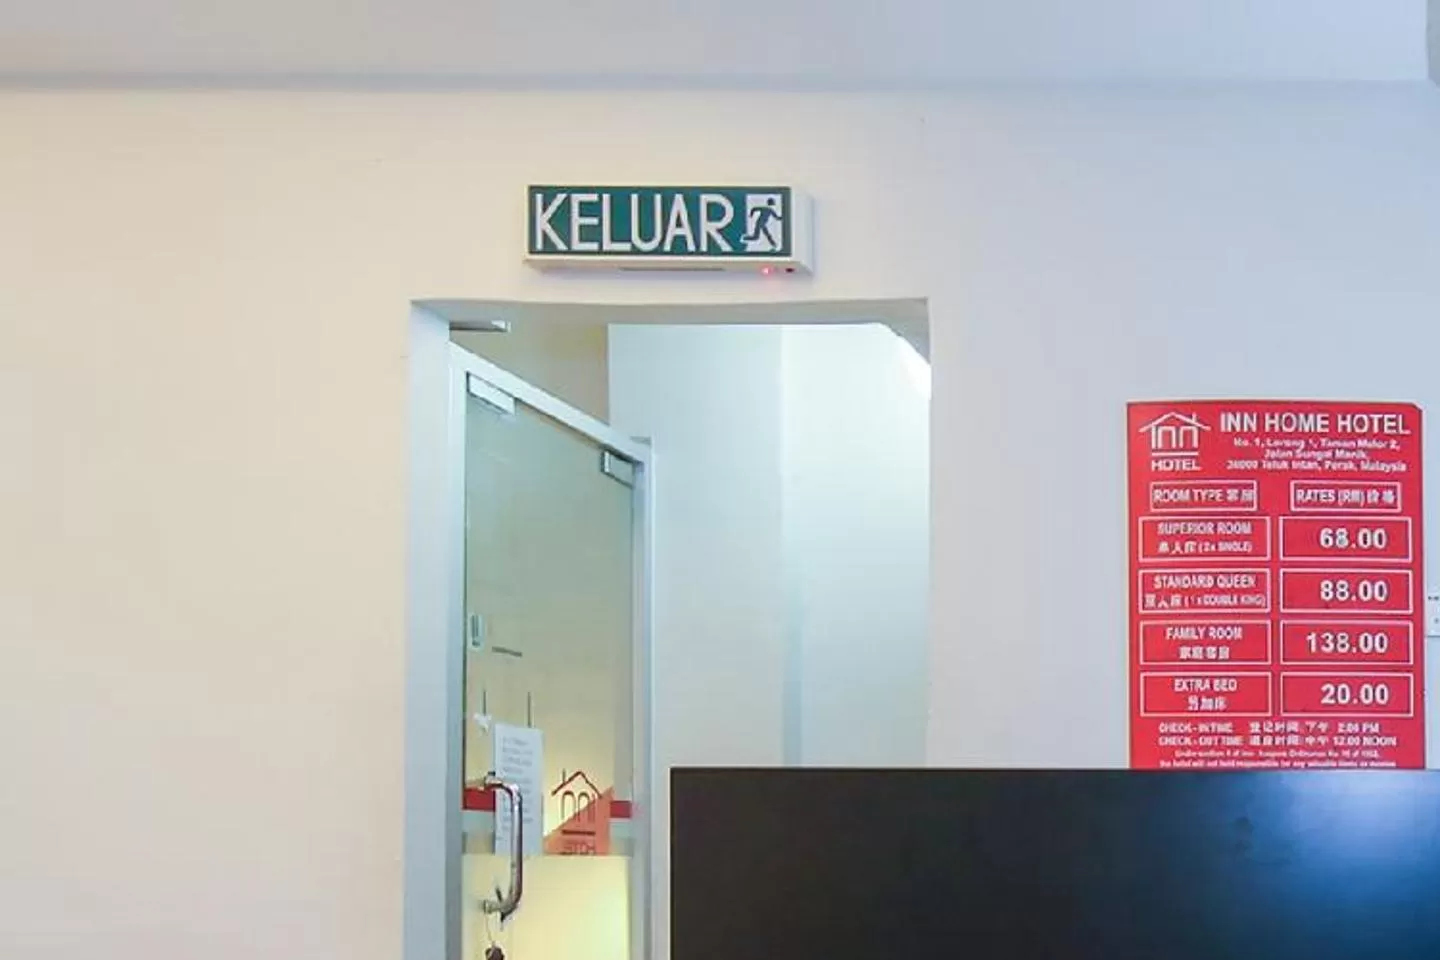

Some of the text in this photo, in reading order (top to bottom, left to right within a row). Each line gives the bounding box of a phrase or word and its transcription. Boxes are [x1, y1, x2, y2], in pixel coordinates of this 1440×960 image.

[535, 193, 734, 252] KELUAR
[1220, 412, 1411, 434] INN HOME HOTEL
[1151, 459, 1201, 472] HOTEL
[1360, 459, 1407, 473] Malaysia
[1153, 488, 1190, 503] ROOM
[1192, 488, 1224, 503] TYPE
[1295, 488, 1336, 503] RATES
[1157, 521, 1253, 535] SUPERIOR ROOM
[1320, 527, 1387, 549] 68.00
[1153, 573, 1257, 589] STANDARD QUEEN
[1320, 579, 1388, 602] 88.00
[1166, 626, 1243, 640] FAMILY ROOM
[1306, 632, 1388, 654] 138.00
[1173, 677, 1238, 692] EXTRA BED
[1320, 683, 1389, 705] 20.00
[1362, 721, 1380, 733] PM
[1362, 735, 1397, 746] NOON
